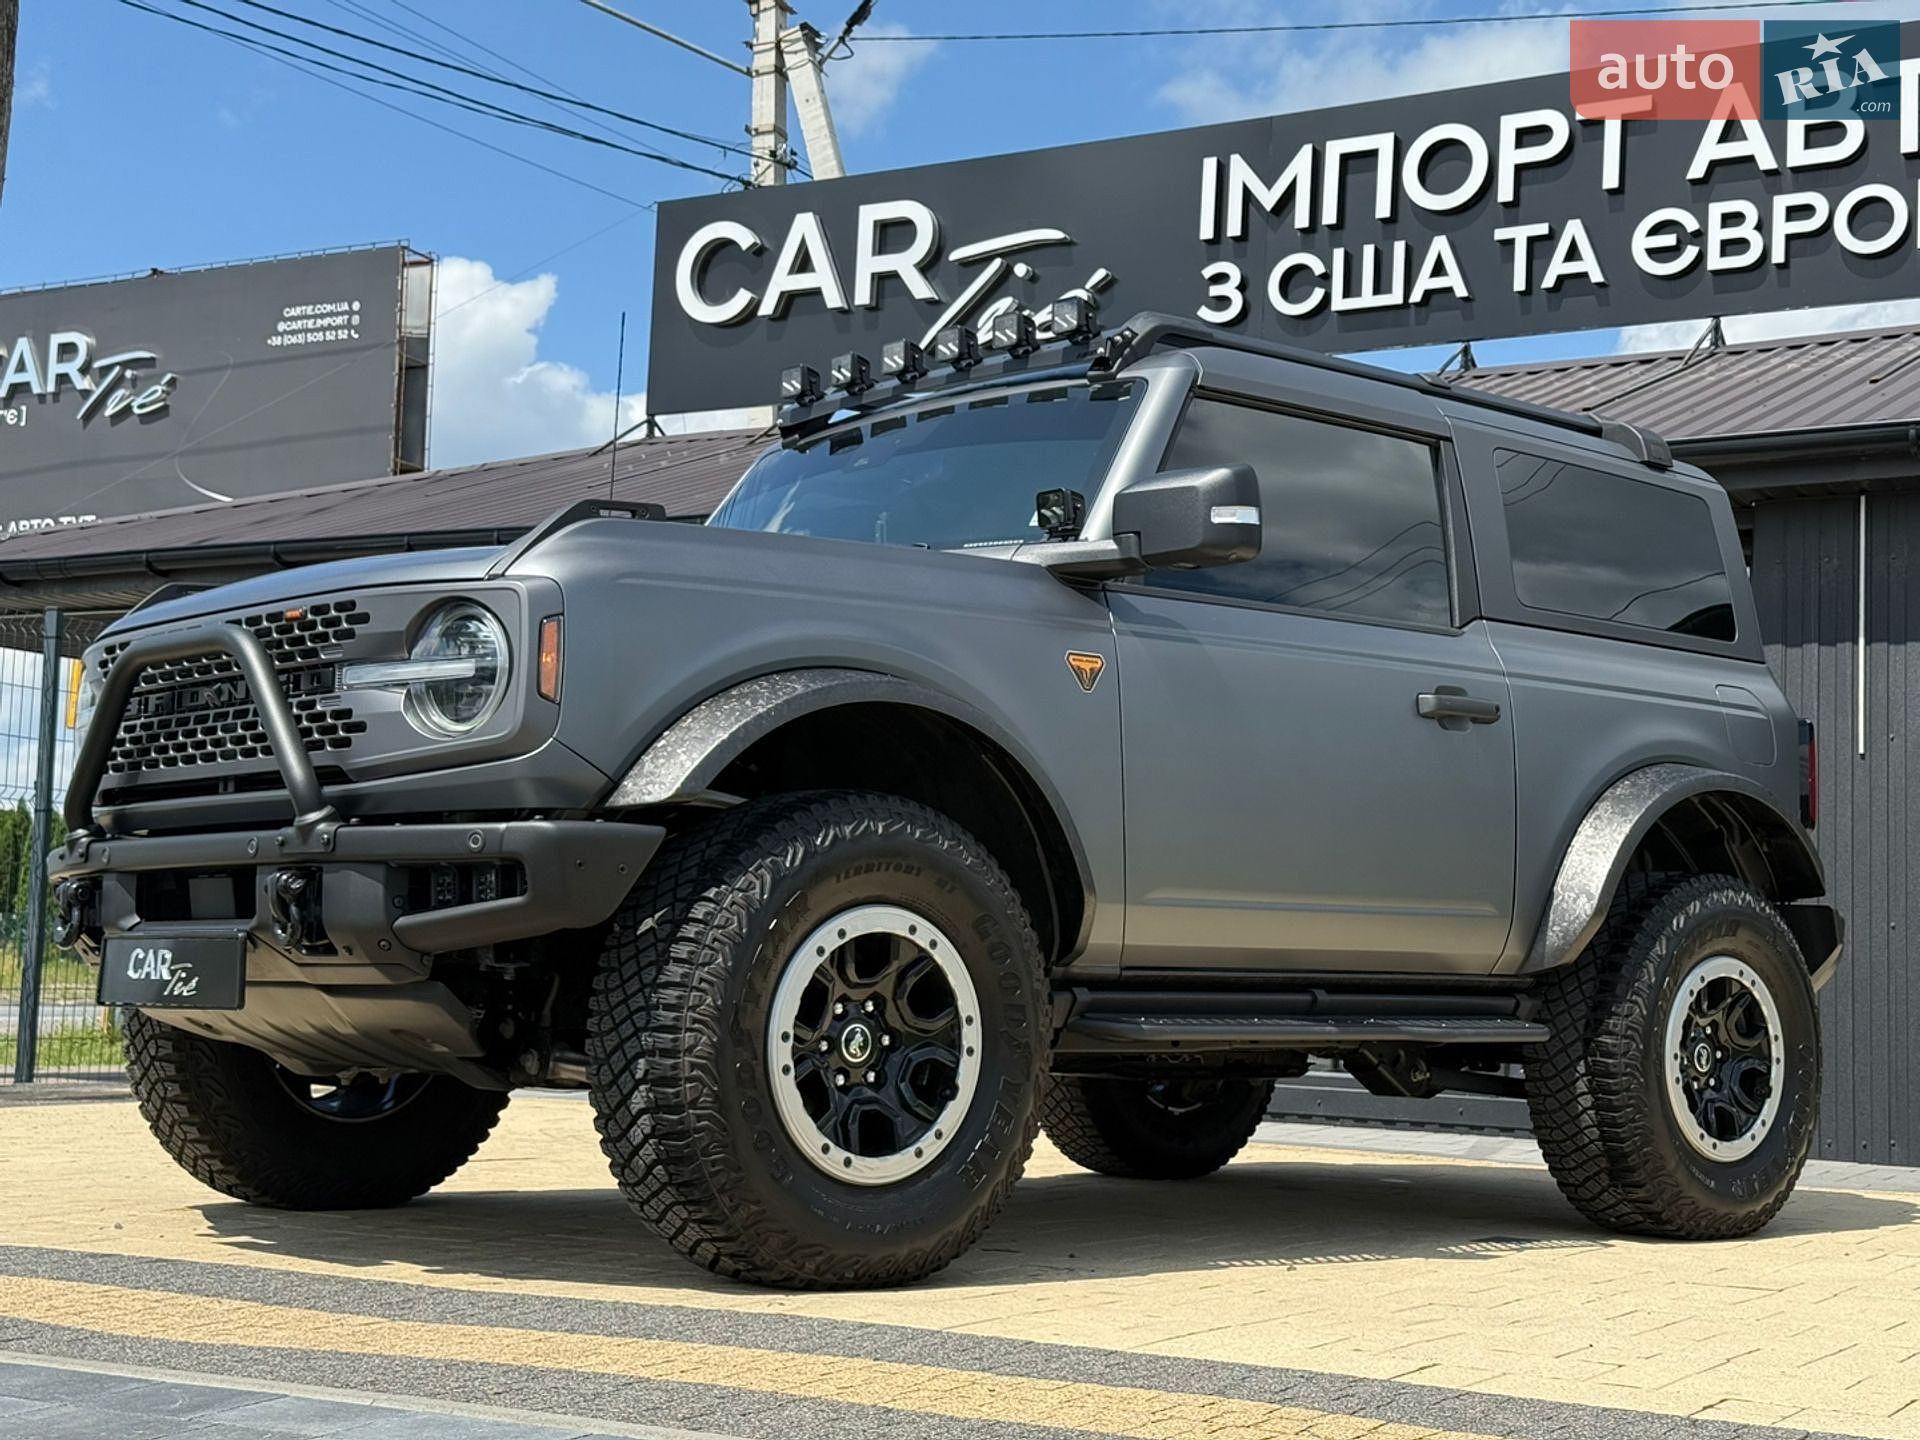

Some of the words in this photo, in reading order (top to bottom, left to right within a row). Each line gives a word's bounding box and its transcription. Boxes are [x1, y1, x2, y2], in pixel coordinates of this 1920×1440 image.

[1200, 94, 1653, 241] ІМПОРТ
[675, 199, 941, 325] CAR
[1196, 261, 1245, 324] З
[1267, 235, 1470, 317] США
[1494, 219, 1605, 293] ТА
[1631, 178, 1920, 277] ЄВРО
[283, 301, 350, 318] CARTIE.COM.UA
[0, 331, 95, 397] AR
[77, 350, 178, 420] Tié
[126, 947, 173, 980] CAR
